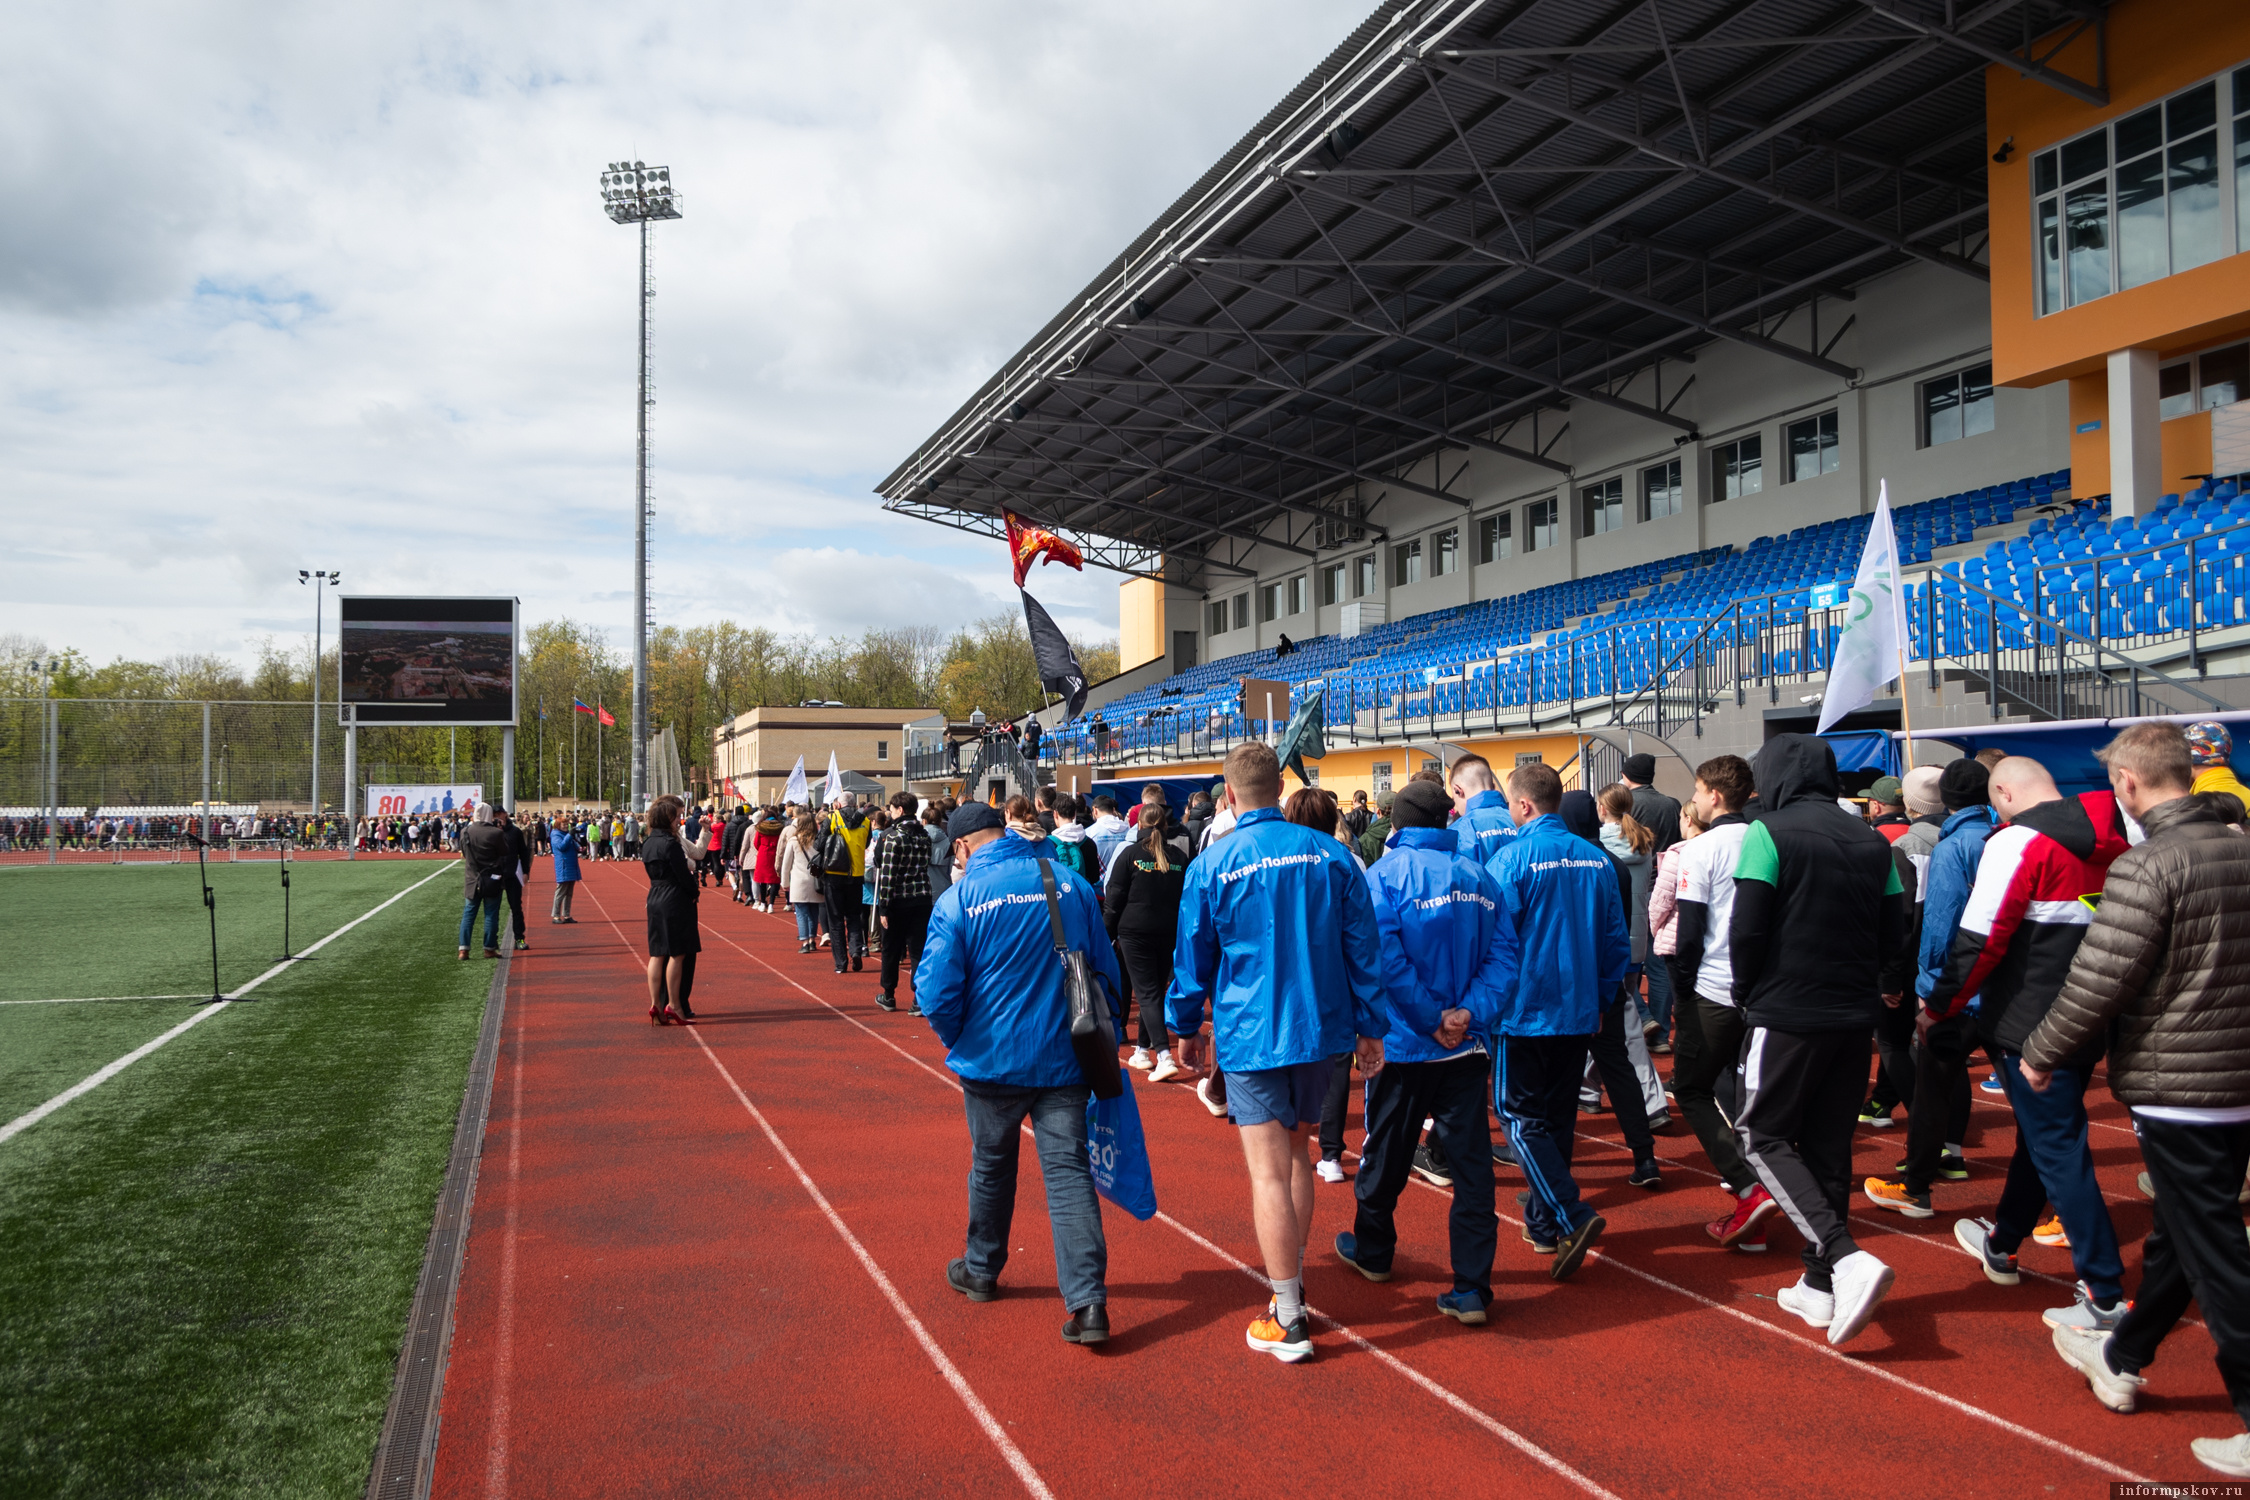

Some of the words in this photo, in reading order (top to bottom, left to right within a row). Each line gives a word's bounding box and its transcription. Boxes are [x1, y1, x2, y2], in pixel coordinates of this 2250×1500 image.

[1818, 594, 1832, 607] Б5
[378, 795, 407, 815] 80
[1218, 854, 1322, 885] Титан-Полимер
[965, 891, 1063, 919] Титан-Полимр
